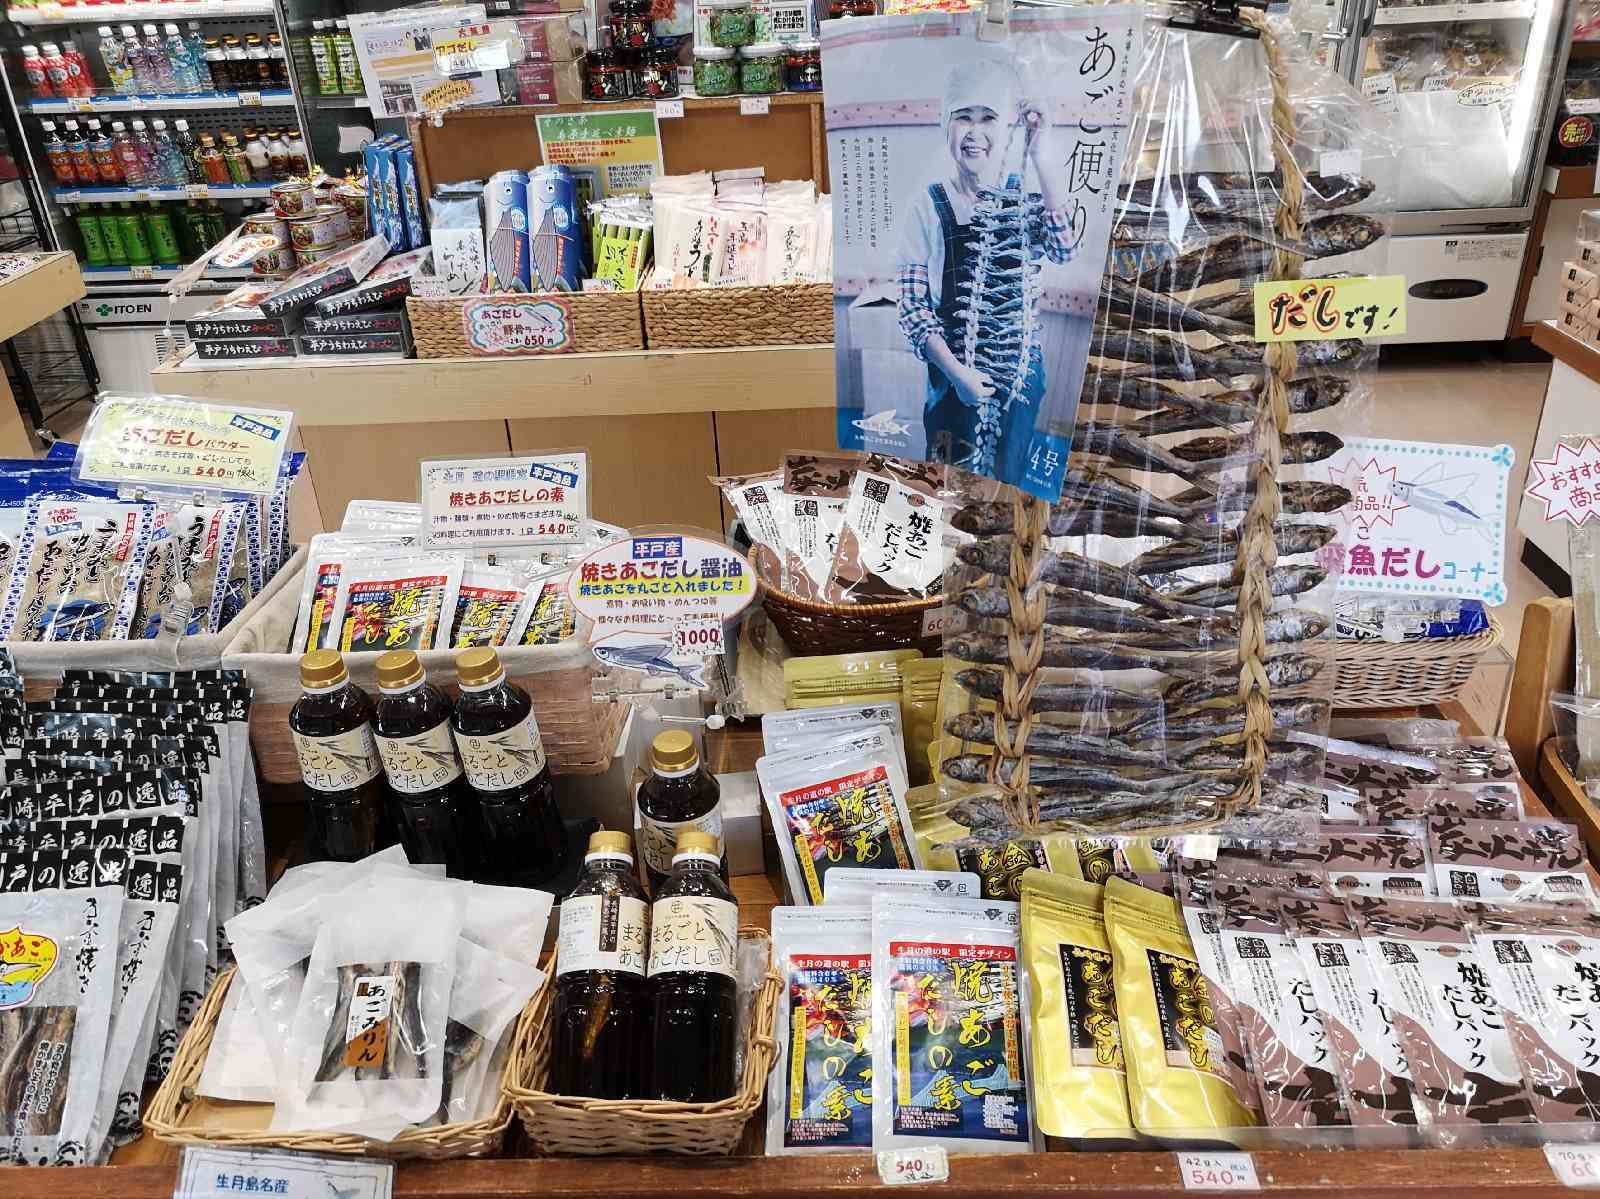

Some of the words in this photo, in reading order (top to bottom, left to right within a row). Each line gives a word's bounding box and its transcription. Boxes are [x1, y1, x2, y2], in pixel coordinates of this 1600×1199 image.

[1064, 26, 1115, 250] あご便り
[114, 304, 135, 314] ITO
[136, 304, 152, 313] EN
[449, 487, 565, 507] 焼きあごだしの素
[634, 540, 681, 557] 平戸産
[876, 522, 903, 574] だしパック
[581, 557, 743, 583] 焼きあごだし醤油
[678, 628, 720, 646] 1000
[959, 946, 1012, 959] 限定デザイン
[1457, 961, 1506, 1030] 焼あご
[357, 985, 386, 1062] あごみりん
[1443, 984, 1486, 1069] だしパック
[216, 1173, 289, 1193] 生月島名産
